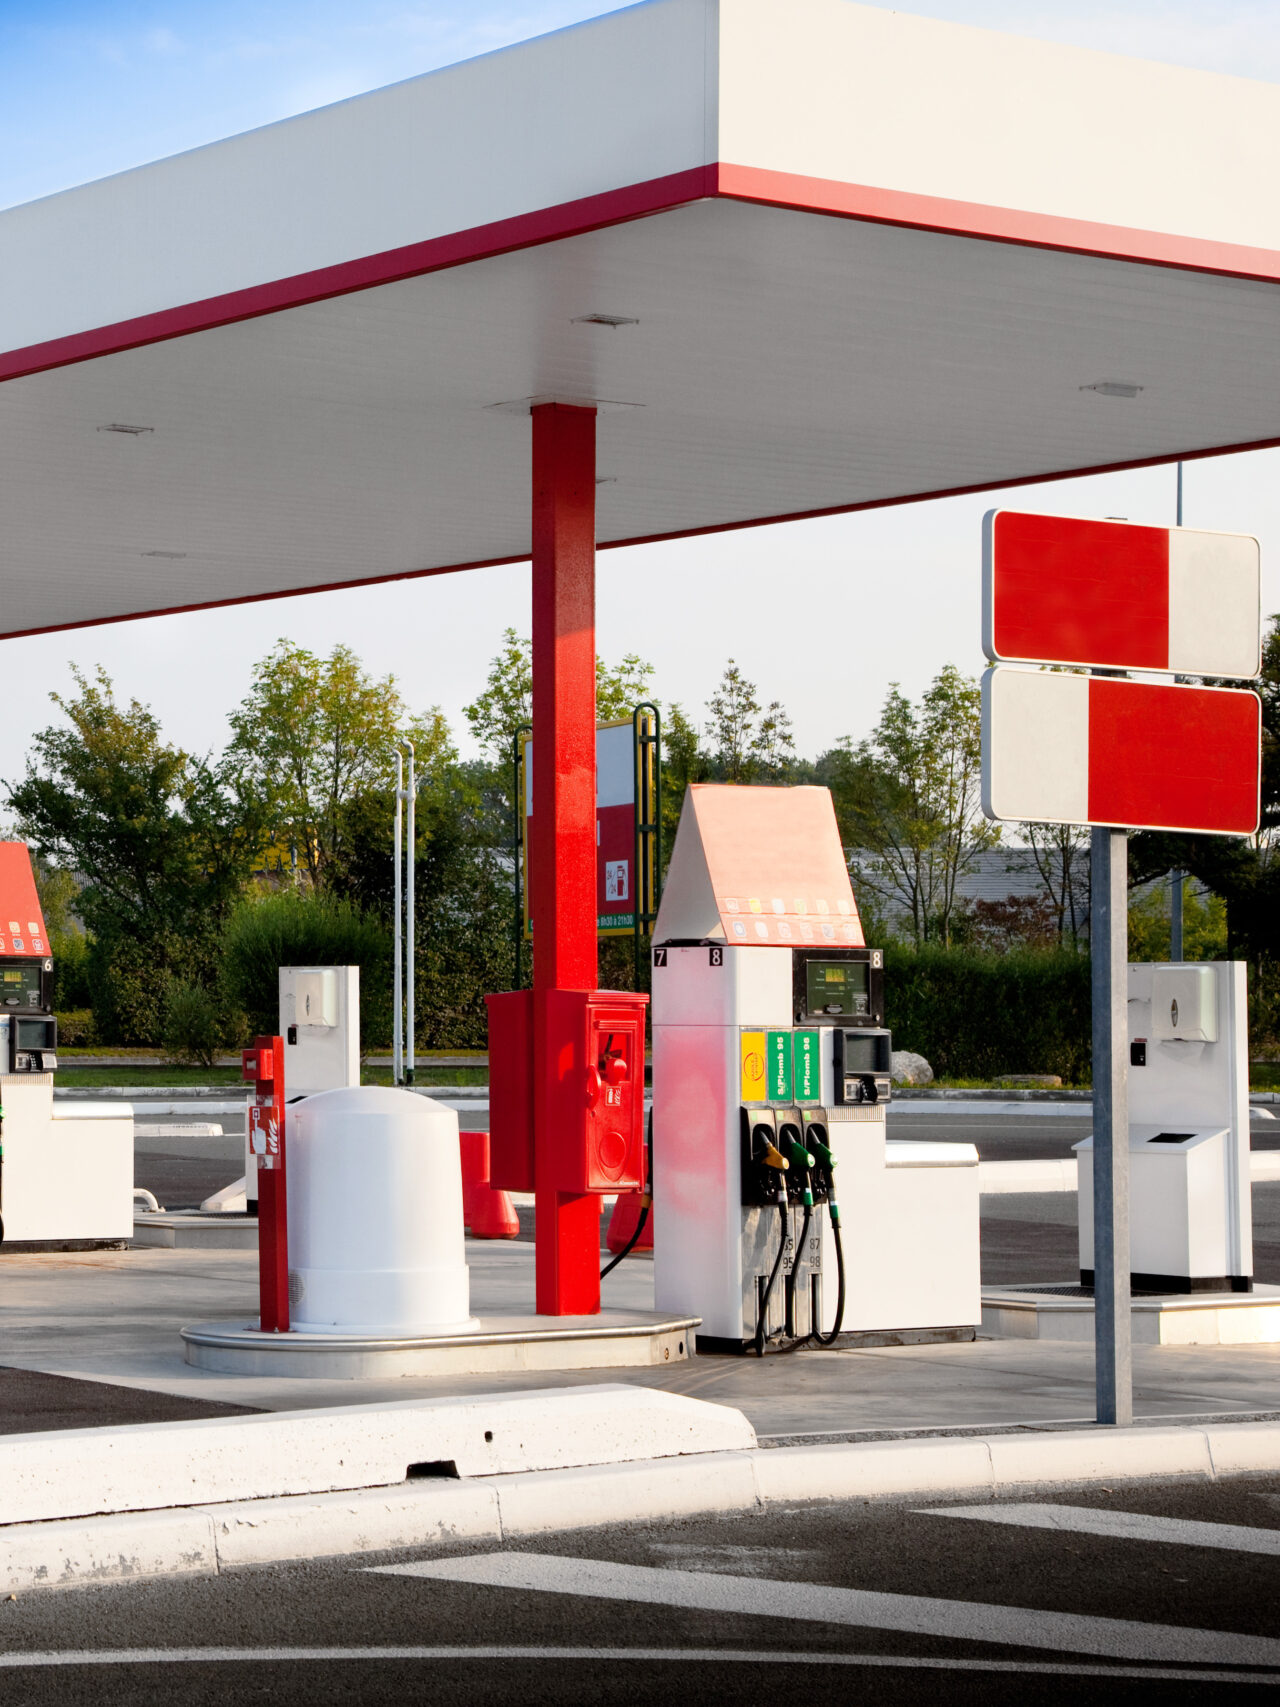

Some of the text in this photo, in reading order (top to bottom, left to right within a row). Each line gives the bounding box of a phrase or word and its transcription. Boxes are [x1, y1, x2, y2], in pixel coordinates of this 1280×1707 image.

[656, 950, 666, 966] 7
[712, 949, 721, 965] 8
[873, 951, 881, 968] 8
[44, 959, 52, 972] 6
[777, 1036, 785, 1096] S/Plomb 95
[803, 1036, 811, 1096] S/Plomb 98
[810, 1238, 820, 1250] 87
[783, 1257, 793, 1269] 95
[810, 1256, 820, 1268] 98
